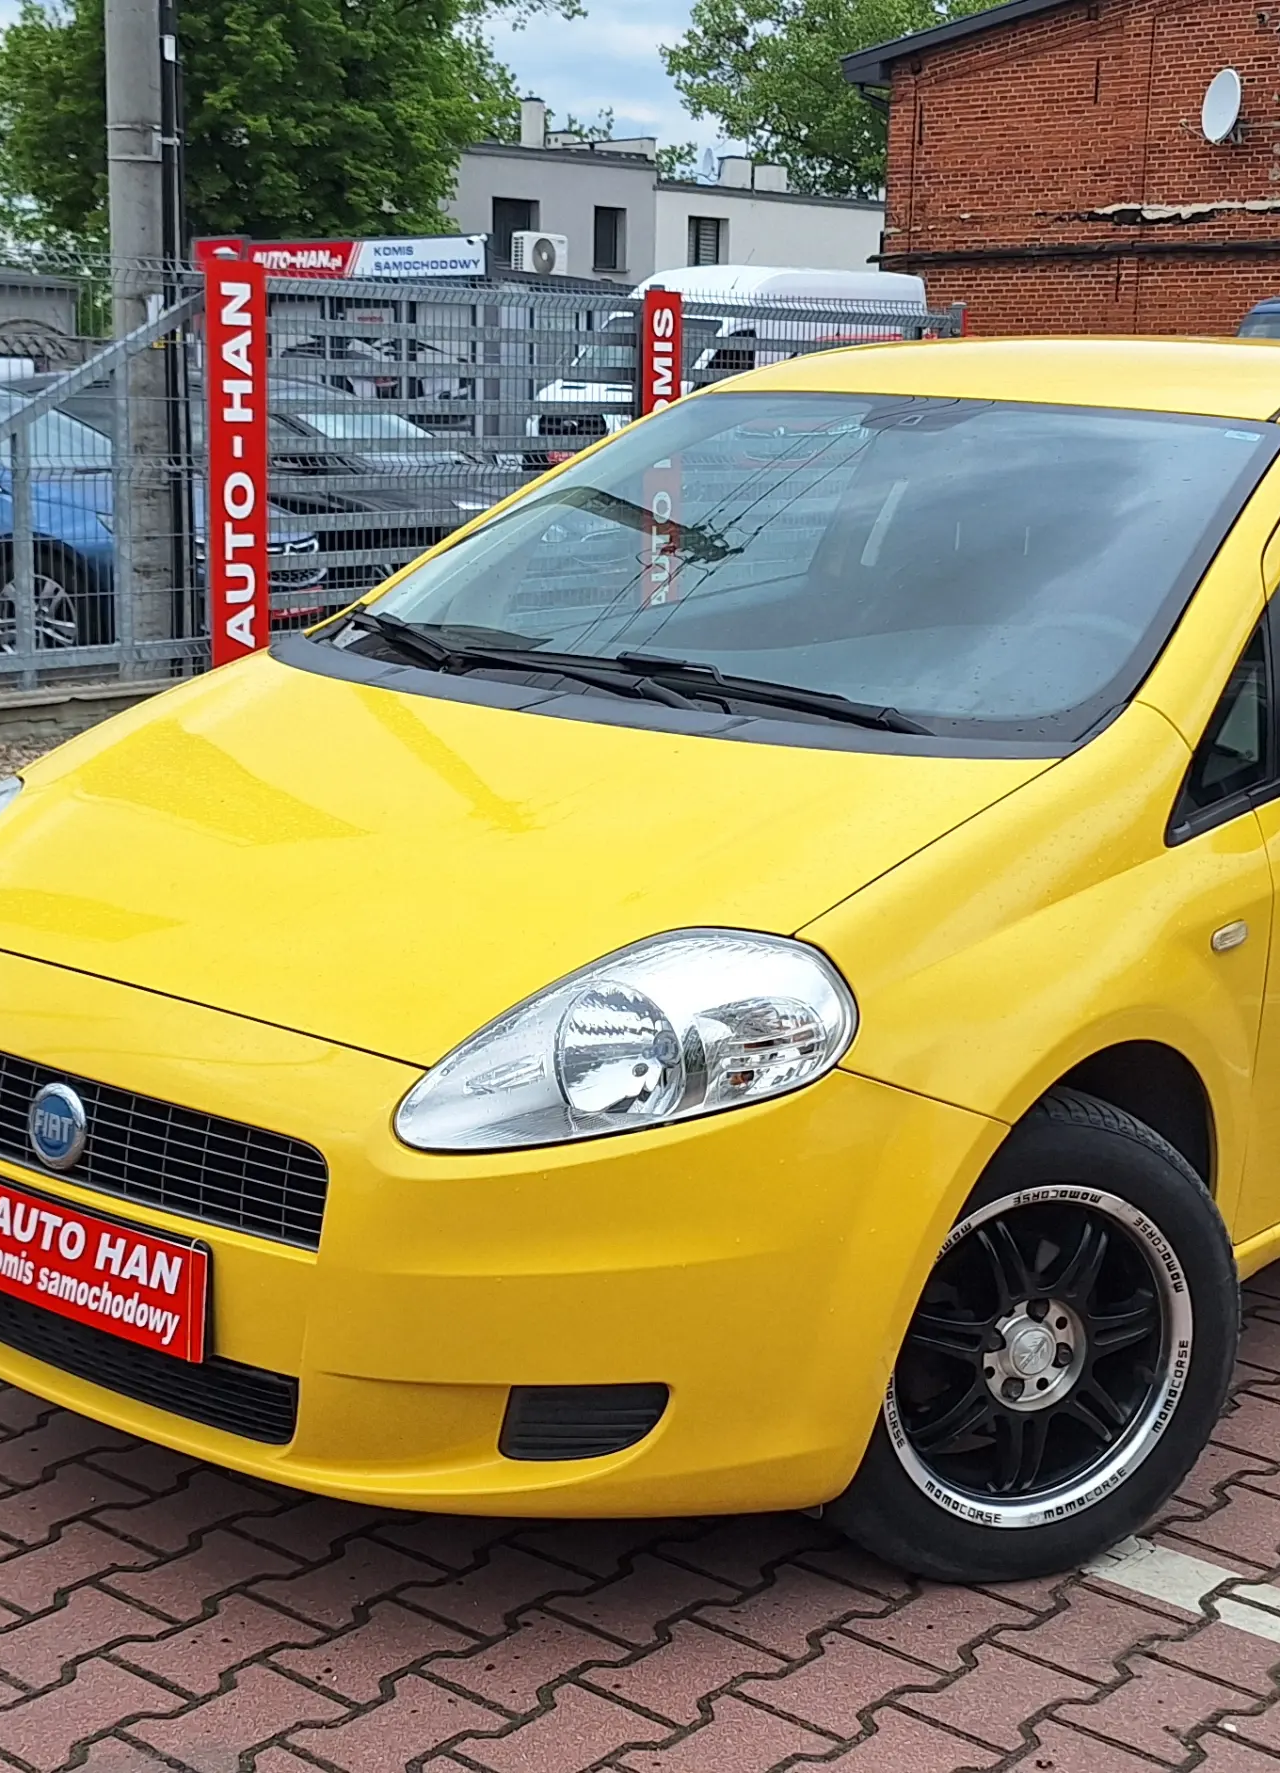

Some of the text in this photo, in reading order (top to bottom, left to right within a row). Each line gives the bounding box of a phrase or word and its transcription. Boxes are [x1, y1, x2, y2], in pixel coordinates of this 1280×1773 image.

[373, 245, 413, 257] KOMIS
[373, 257, 481, 271] SAMOCHODOWY
[34, 1109, 73, 1145] FIAT
[94, 1232, 183, 1295] HAN
[37, 1268, 181, 1346] samochodowy
